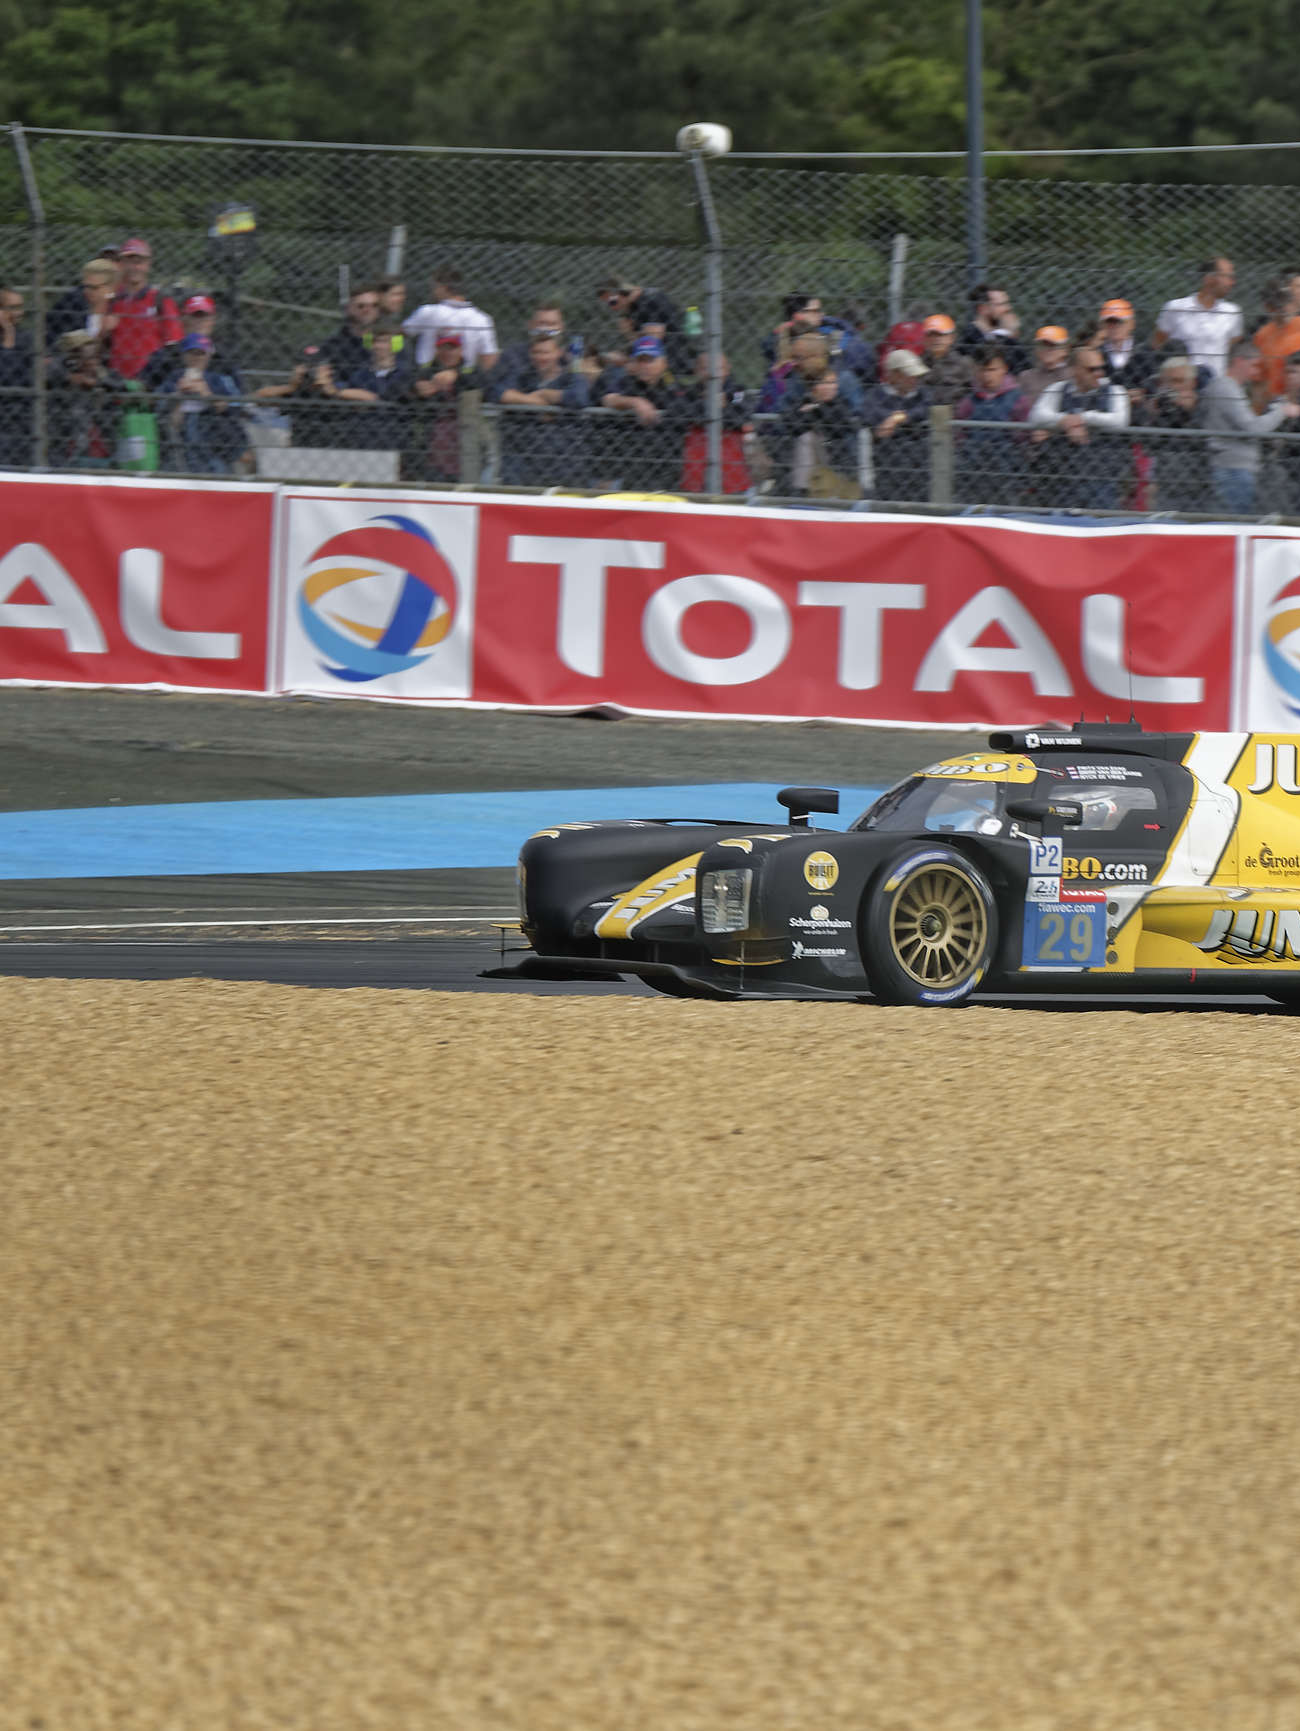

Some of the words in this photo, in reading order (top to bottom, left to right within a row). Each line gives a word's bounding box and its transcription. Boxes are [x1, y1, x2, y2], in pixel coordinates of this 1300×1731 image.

[508, 535, 1205, 704] TOTAL
[1035, 845, 1058, 867] P2
[1245, 856, 1257, 868] de
[1260, 847, 1300, 868] Groot
[1038, 913, 1093, 962] 29
